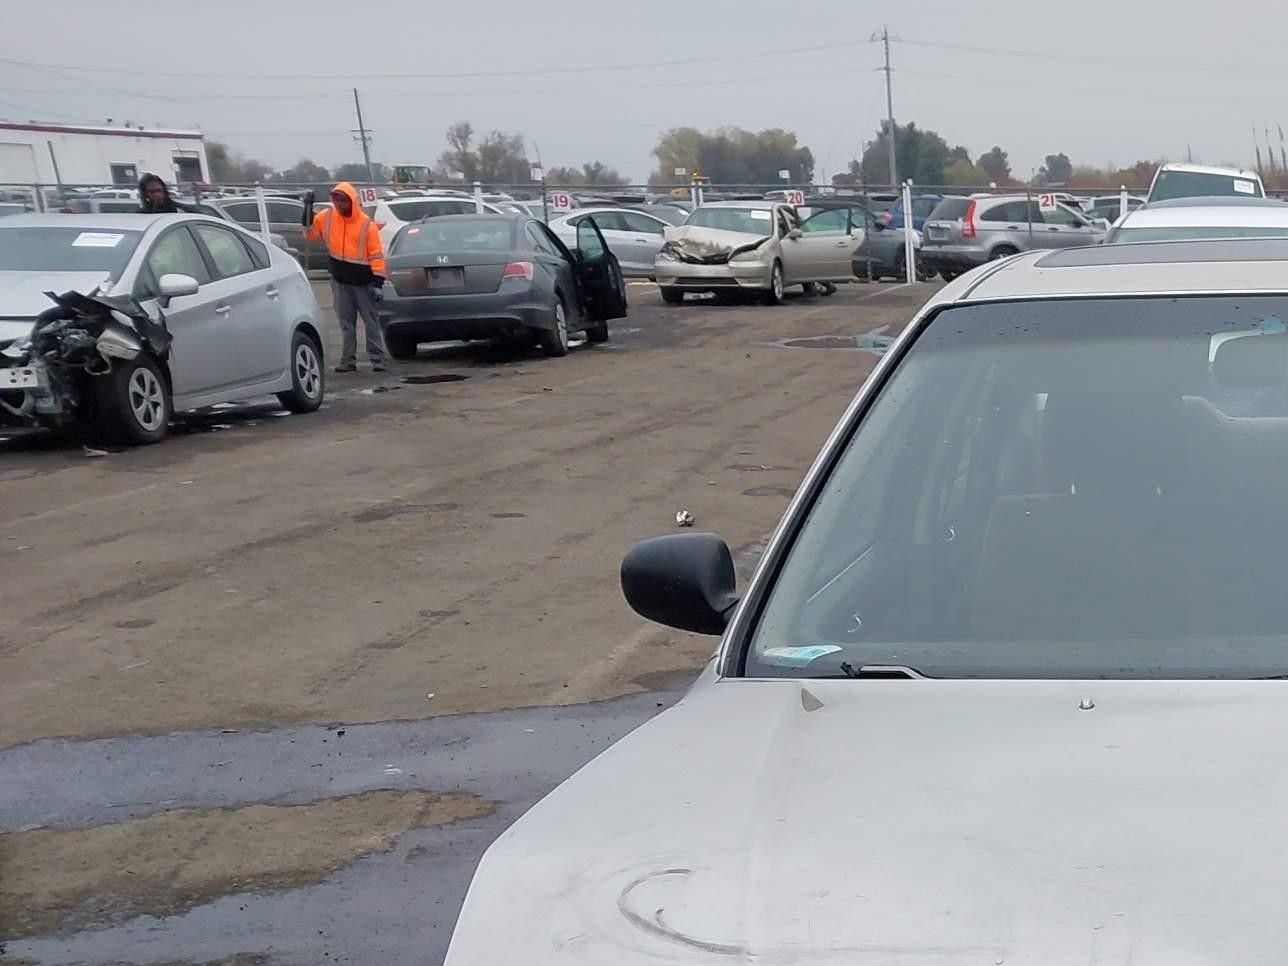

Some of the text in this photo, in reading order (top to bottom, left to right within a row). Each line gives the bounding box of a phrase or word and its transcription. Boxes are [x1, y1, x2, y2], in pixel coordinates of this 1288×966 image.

[361, 189, 375, 203] 18
[554, 195, 569, 208] 19
[788, 191, 802, 204] 20
[1041, 195, 1055, 207] 21
